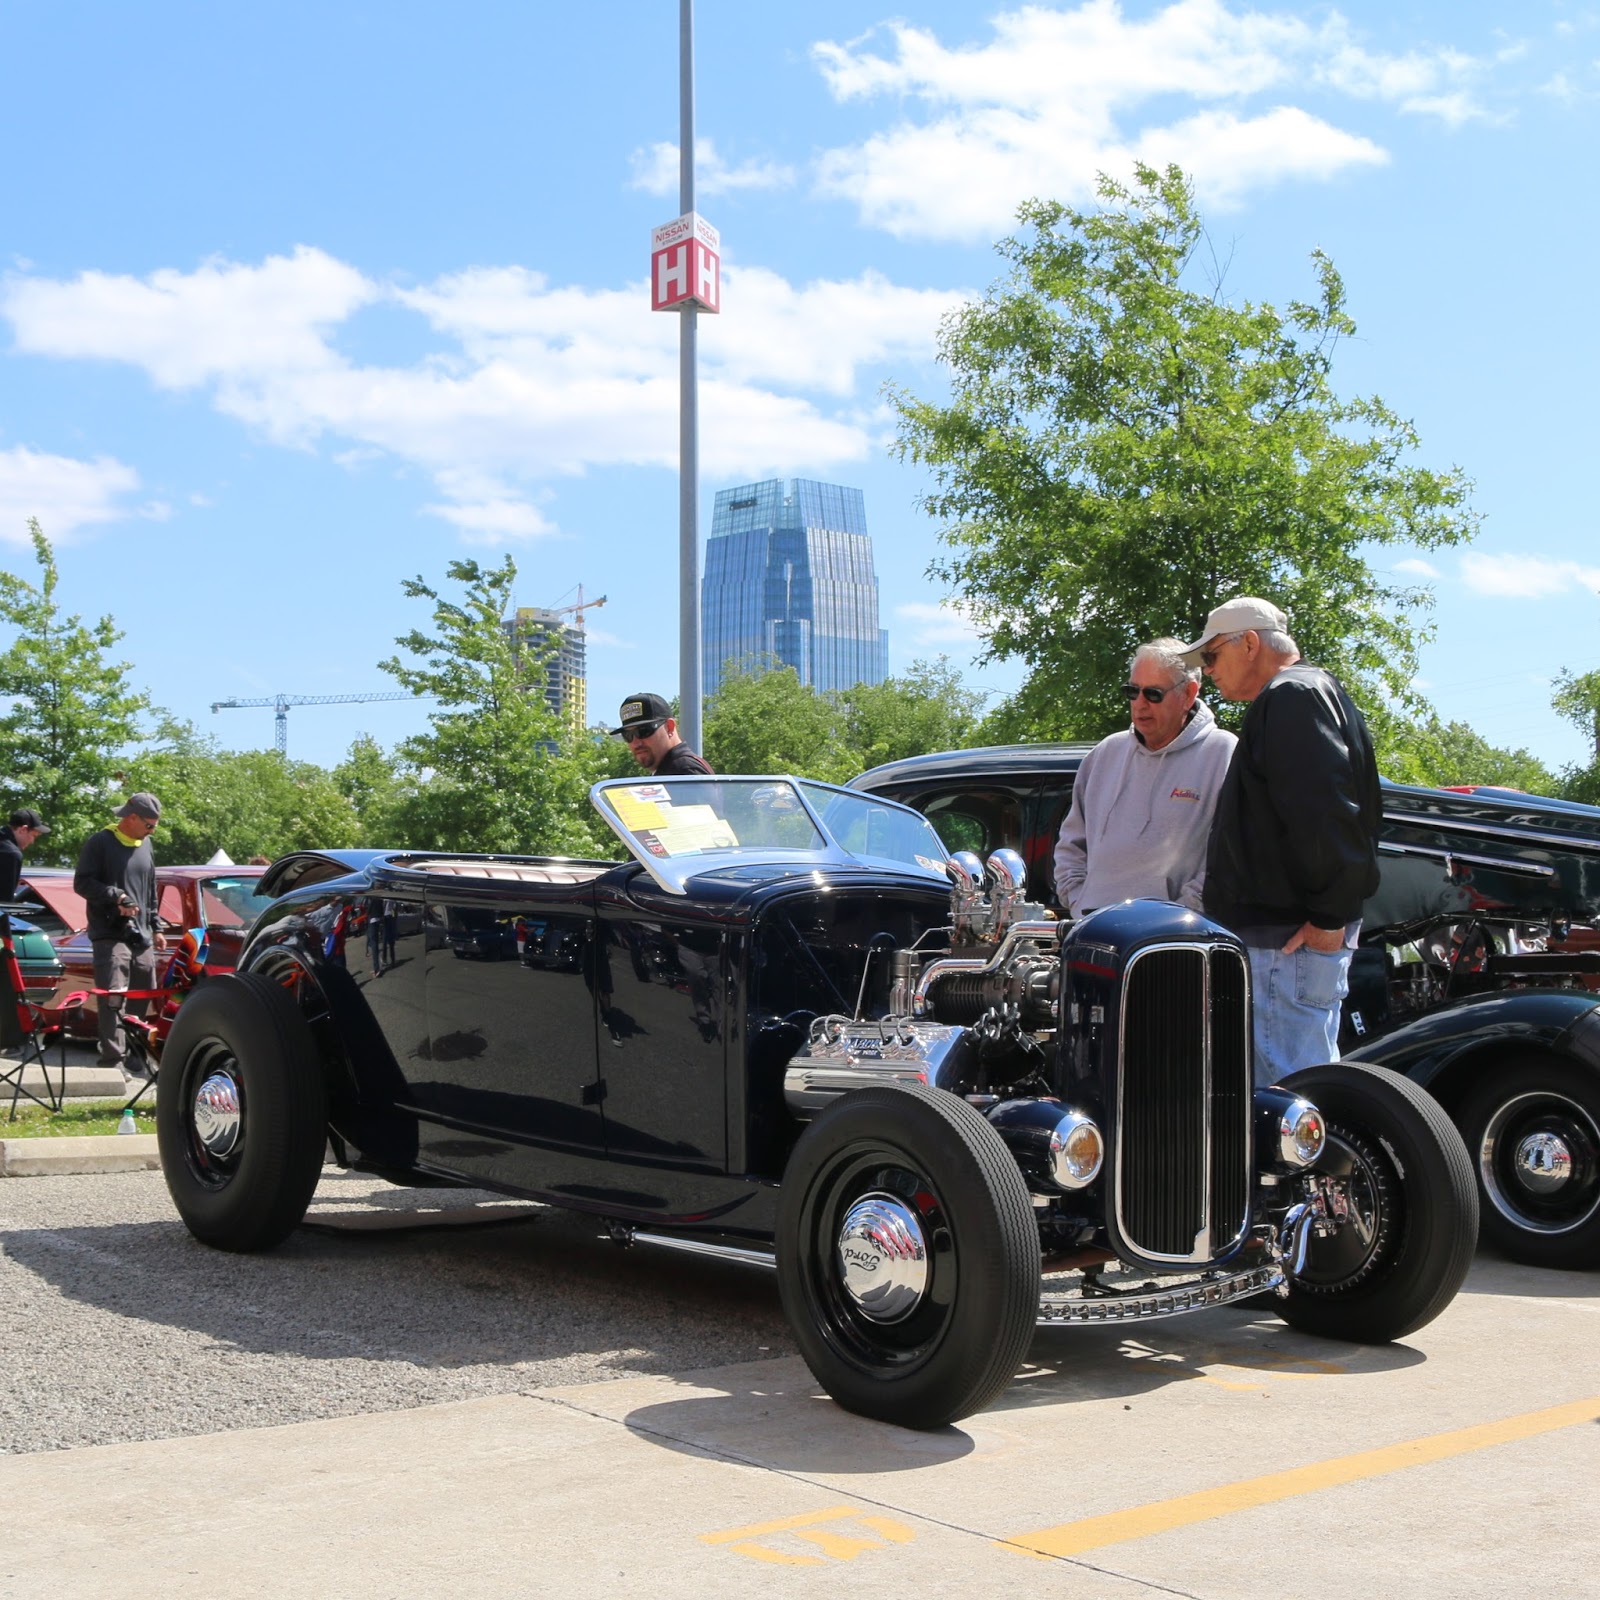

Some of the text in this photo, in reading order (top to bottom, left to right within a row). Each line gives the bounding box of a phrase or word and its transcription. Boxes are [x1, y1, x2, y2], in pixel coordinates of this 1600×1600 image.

[656, 222, 690, 243] NISSAN
[662, 234, 684, 246] STADIUM
[697, 222, 717, 246] NISSAN
[658, 245, 686, 304] H
[698, 246, 716, 306] H
[844, 1248, 880, 1272] Ford
